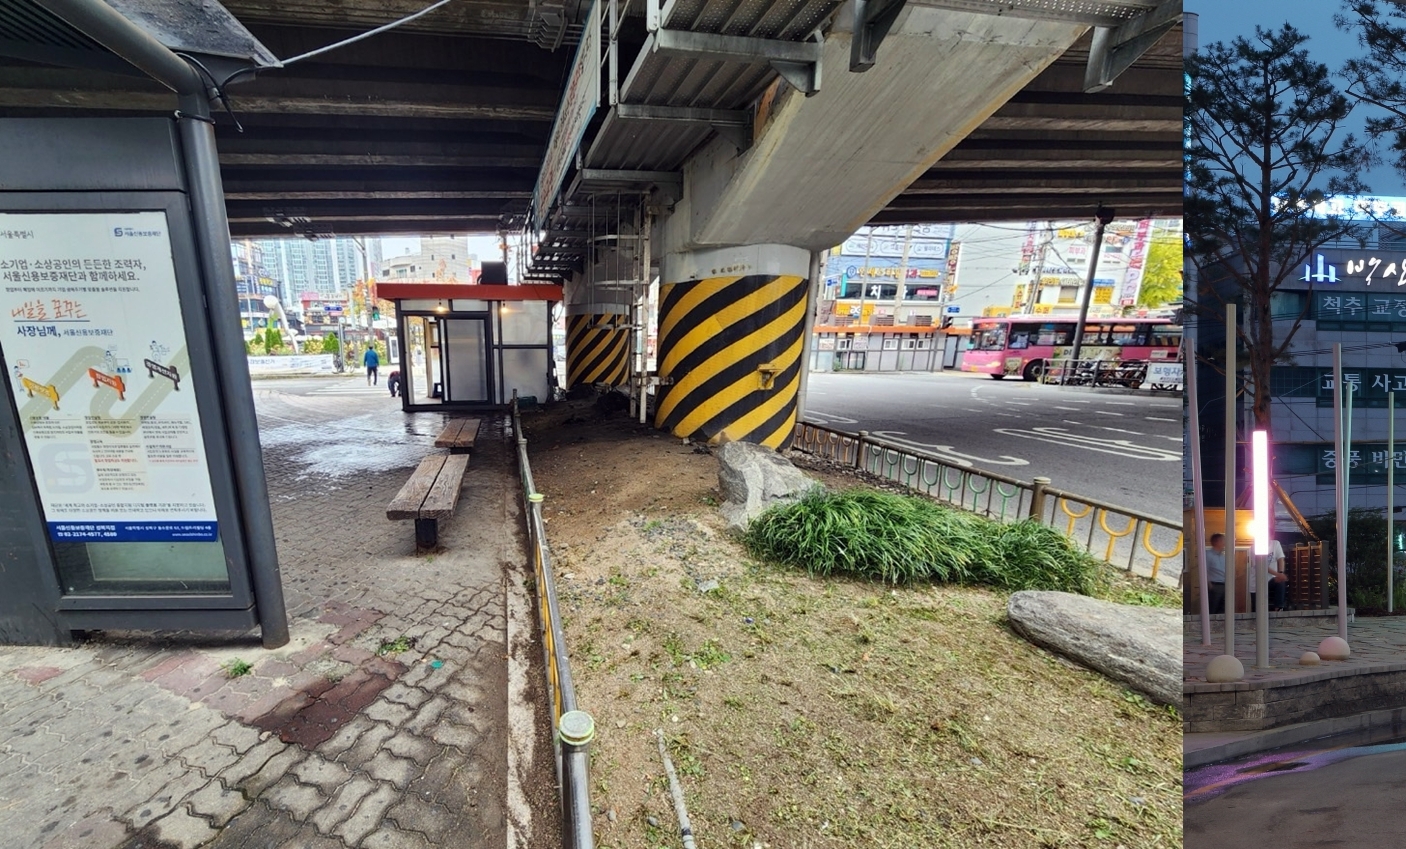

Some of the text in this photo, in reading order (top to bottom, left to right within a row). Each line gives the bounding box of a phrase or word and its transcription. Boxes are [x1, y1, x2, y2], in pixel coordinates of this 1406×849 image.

[84, 259, 111, 270] 든든한
[114, 259, 147, 271] 조력자,
[3, 271, 140, 282] 서울신용보증재단과 함께하세요.
[11, 299, 87, 320] 내일을 꿈꾸는
[1322, 295, 1363, 316] 척추
[17, 326, 61, 338] 사장님께,
[1322, 373, 1361, 392] 교통
[1322, 449, 1361, 468] 중풍
